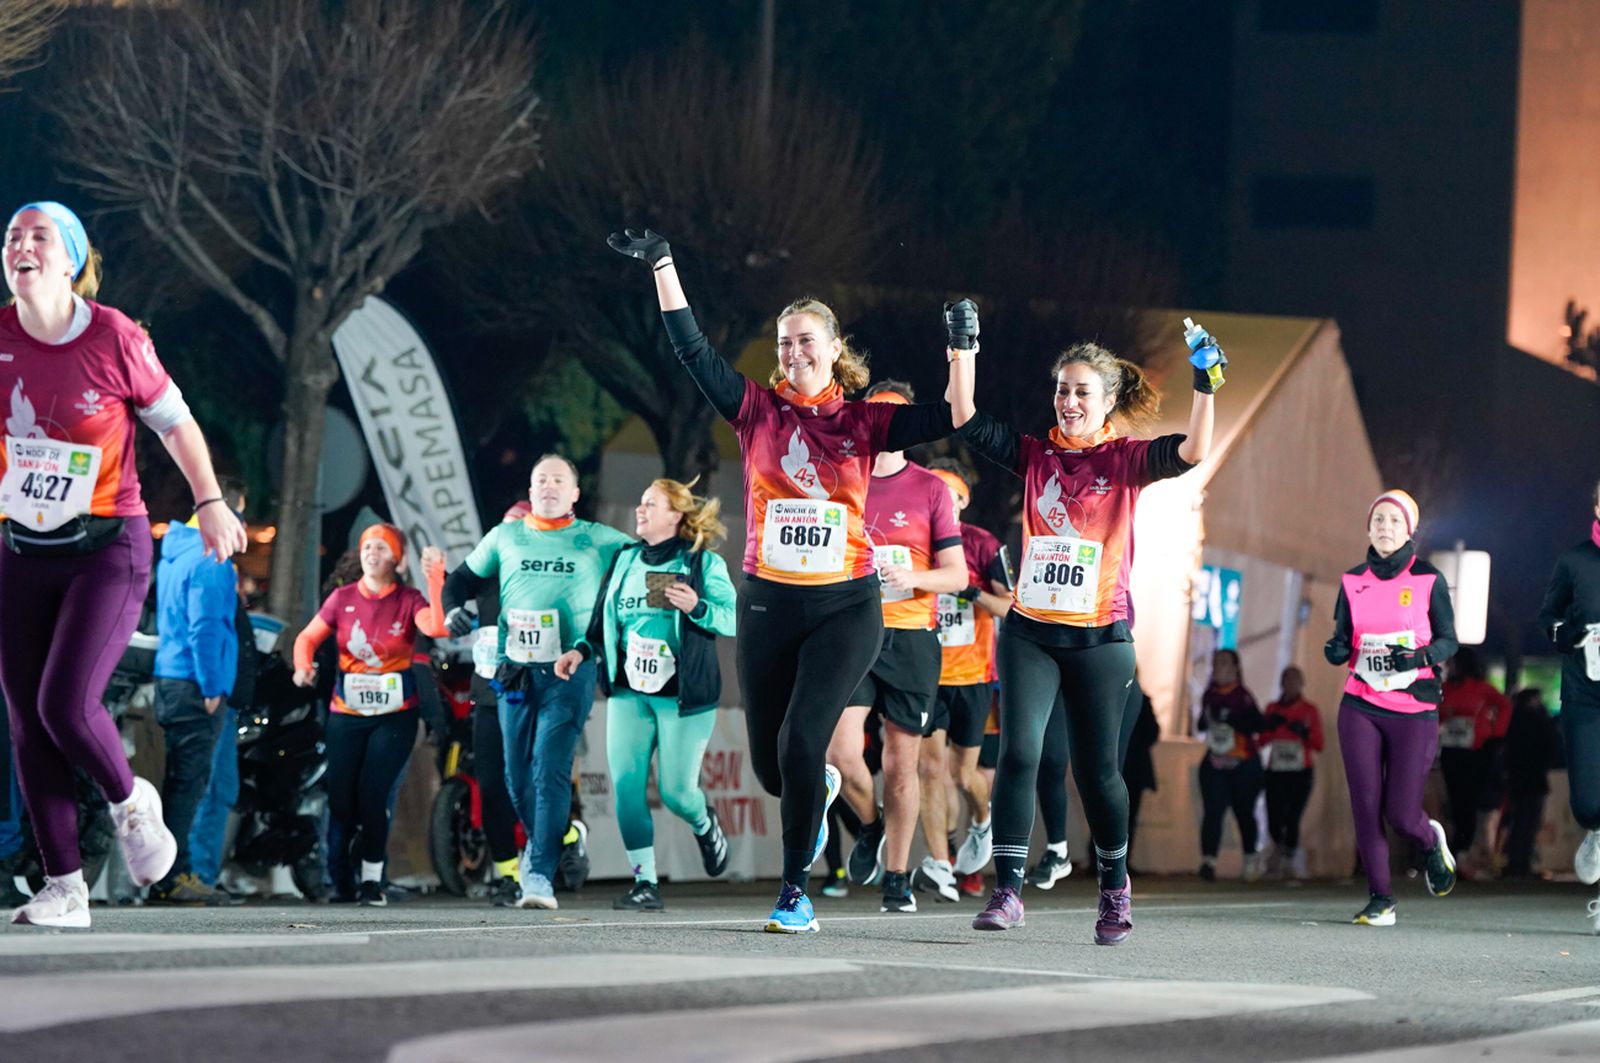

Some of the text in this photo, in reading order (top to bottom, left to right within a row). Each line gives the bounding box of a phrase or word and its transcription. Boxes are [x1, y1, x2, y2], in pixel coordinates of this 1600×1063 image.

[392, 347, 476, 552] JAPEMASA
[794, 467, 815, 488] 43
[21, 472, 74, 502] 4327
[774, 516, 790, 524] SAN
[791, 515, 818, 524] ANTÓN
[1047, 507, 1066, 528] 43
[780, 525, 832, 547] 6867
[1061, 544, 1071, 553] DE
[521, 557, 576, 573] serás
[1033, 562, 1085, 587] 5806
[618, 596, 647, 610] ser
[519, 630, 540, 645] 417
[634, 656, 658, 675] 416
[1366, 655, 1393, 672] 165
[359, 690, 390, 705] 1987
